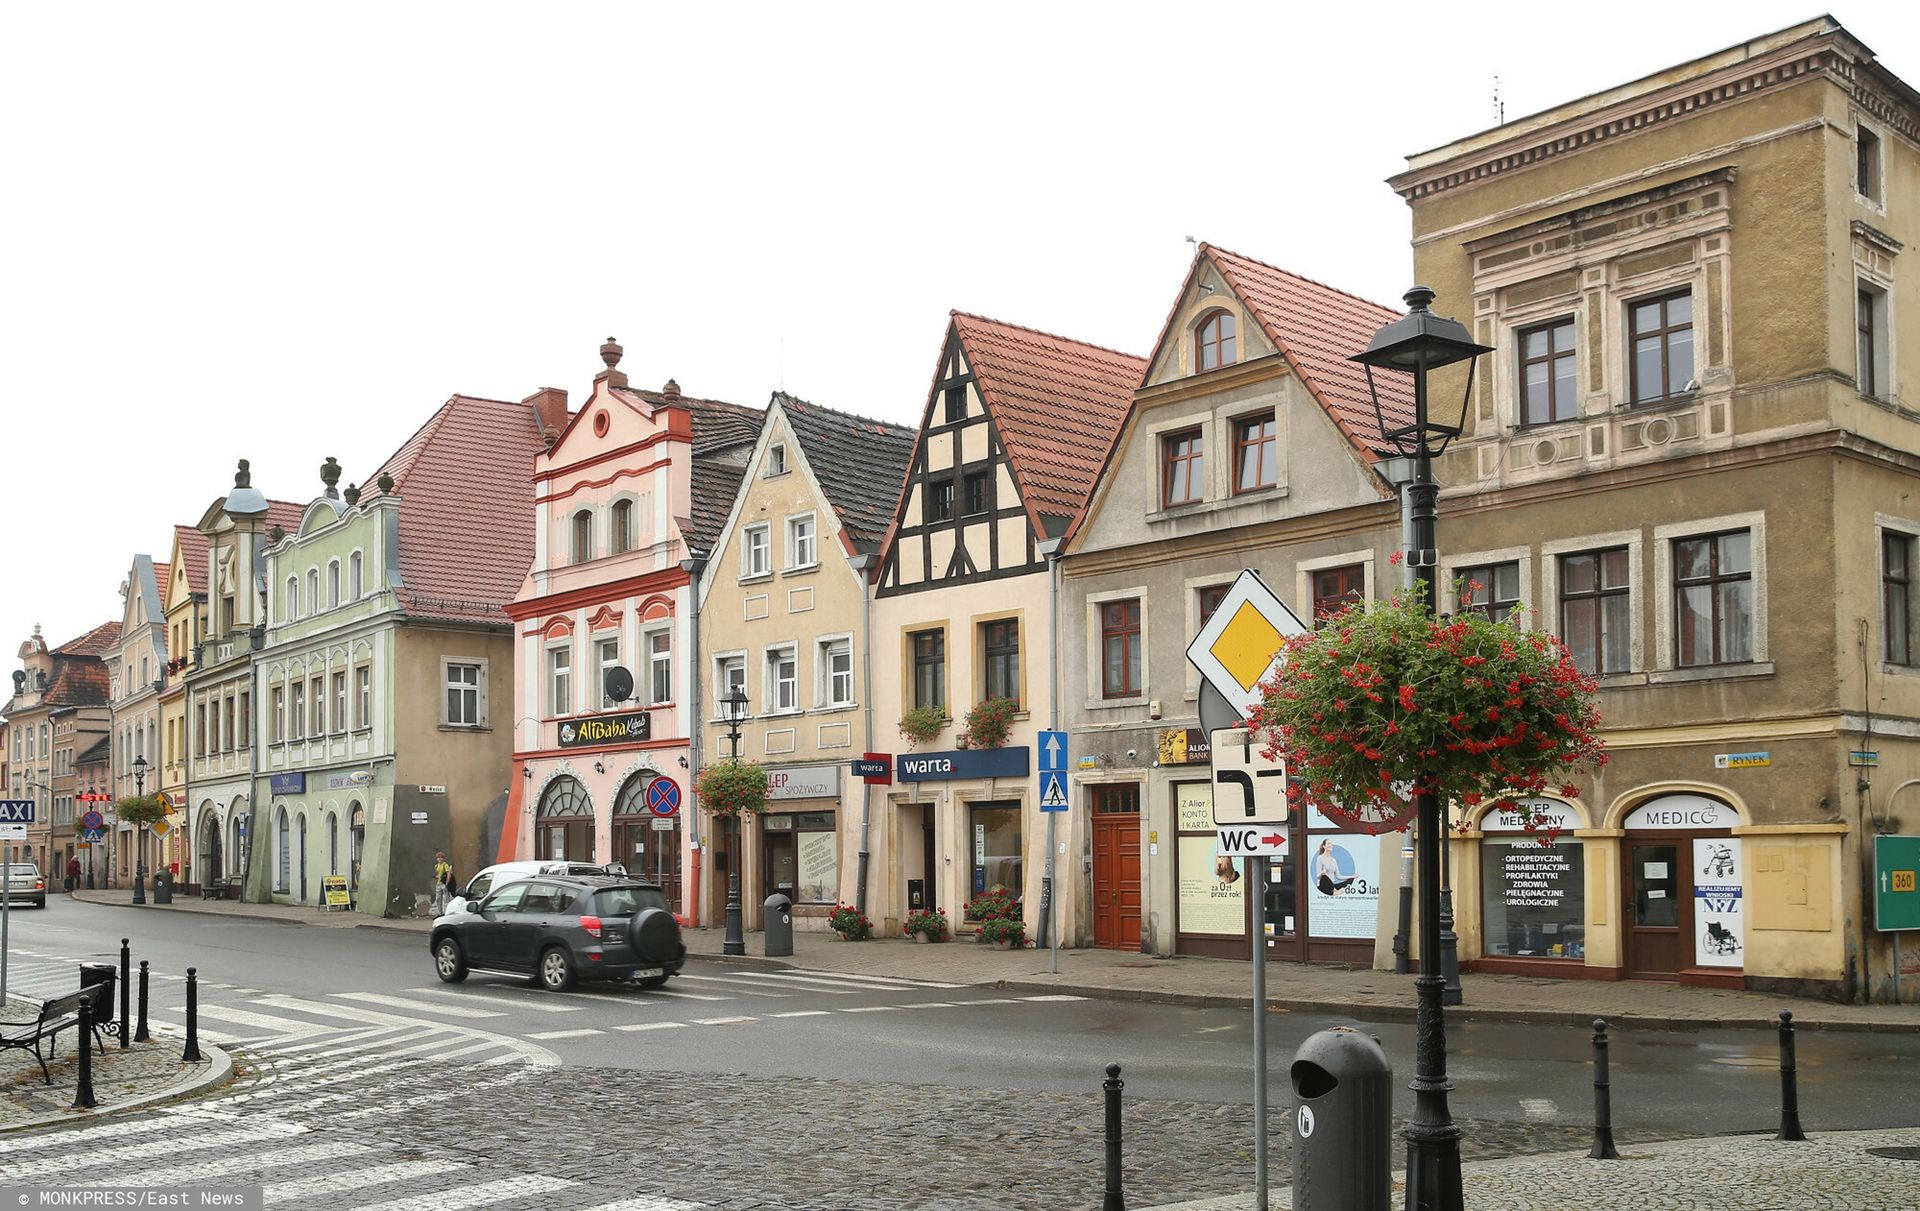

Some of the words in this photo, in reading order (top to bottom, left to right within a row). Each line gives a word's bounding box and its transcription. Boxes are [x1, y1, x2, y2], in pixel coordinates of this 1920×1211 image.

[578, 720, 626, 741] AliBaba
[1188, 743, 1211, 752] ALIOR
[1188, 752, 1209, 760] BANK
[1733, 755, 1766, 765] RYNEK
[860, 763, 883, 772] warta
[1188, 800, 1205, 808] Alior
[0, 803, 32, 820] AXI
[1182, 810, 1208, 819] KONTO
[1186, 821, 1210, 829] KARTA
[1220, 830, 1258, 851] WC
[1505, 855, 1564, 863] ORTOPEDYCZNE
[1505, 872, 1558, 880] PROFILAKTYKI
[1895, 874, 1912, 888] 360
[1344, 885, 1356, 894] do
[1358, 879, 1367, 894] 3
[1369, 885, 1379, 894] lat
[1506, 889, 1565, 898] PIELĘGNACYJNE
[1704, 899, 1738, 913] NFZ
